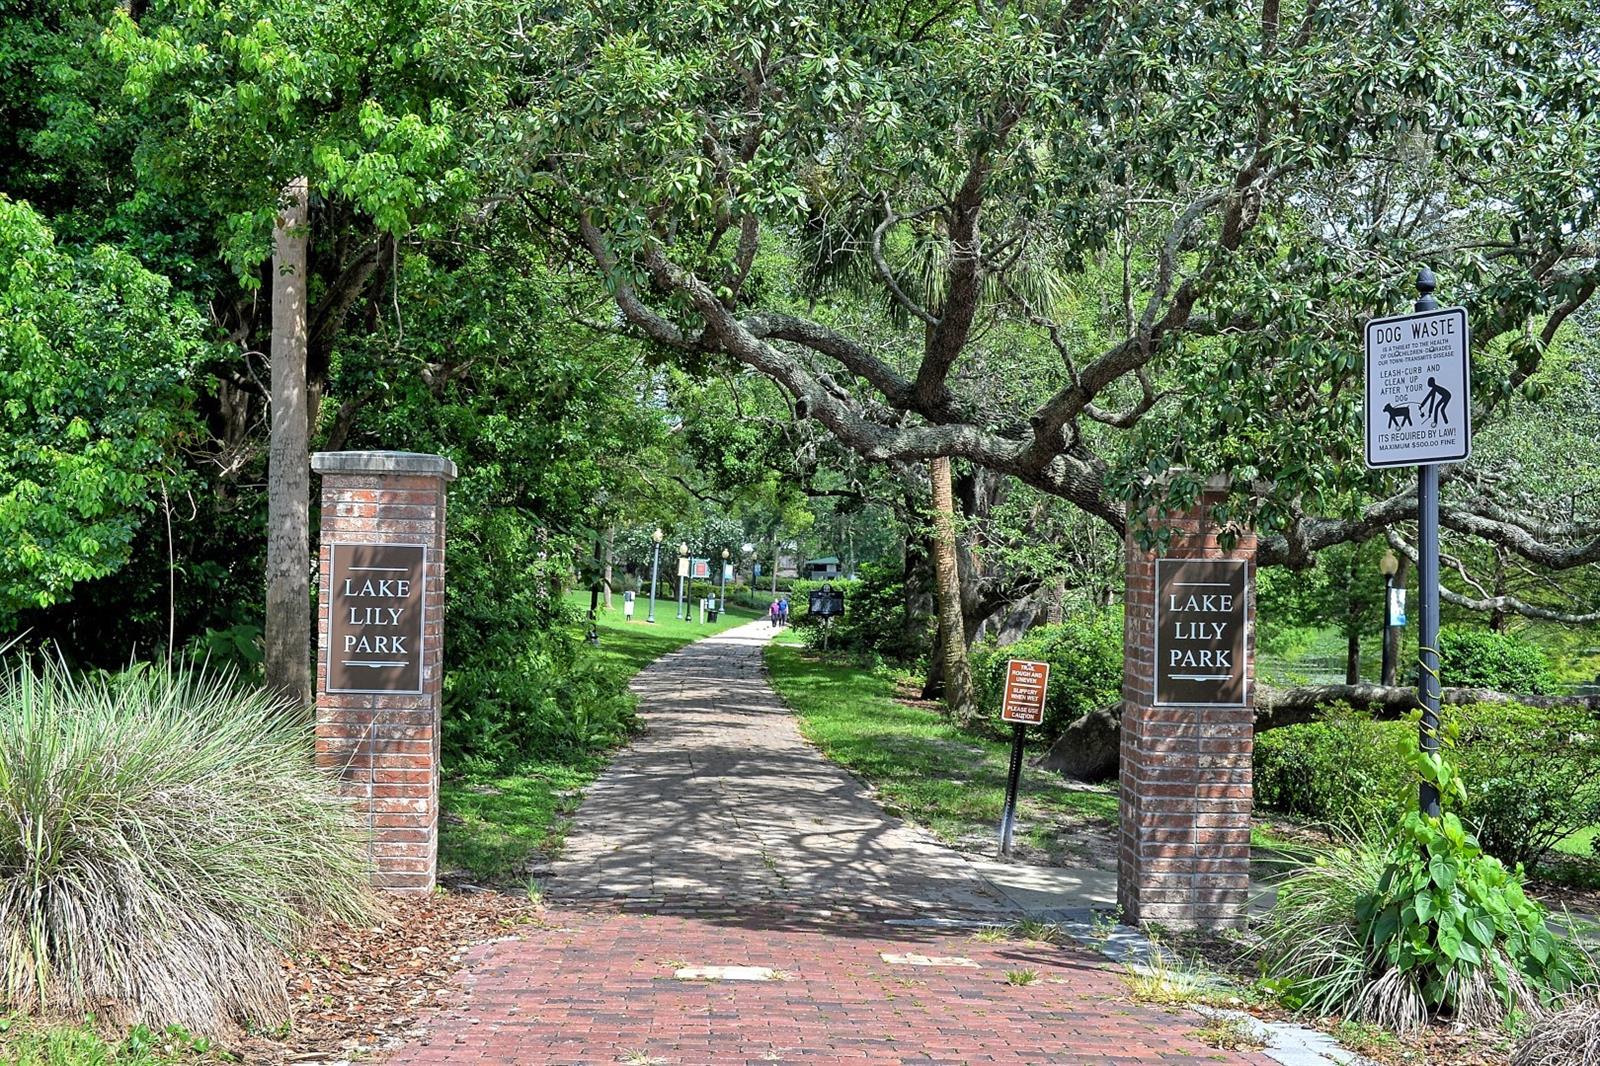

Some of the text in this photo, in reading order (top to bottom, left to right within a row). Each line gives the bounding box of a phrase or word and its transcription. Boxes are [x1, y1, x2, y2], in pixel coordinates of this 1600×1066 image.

[1377, 318, 1454, 344] DOG WASTE
[1380, 364, 1440, 378] LEASH-CURB AND
[1380, 384, 1423, 395] AFTER YOUR
[1385, 377, 1405, 386] CLEAN
[1378, 428, 1456, 443] ITS REQUIRED BY LAW!
[1412, 440, 1438, 449] $500.00
[344, 578, 410, 598] LAKE
[1169, 594, 1233, 612] LAKE
[350, 608, 404, 625] LILY
[1174, 622, 1227, 639] LILY
[344, 636, 408, 654] PARK
[1169, 650, 1231, 667] PARK
